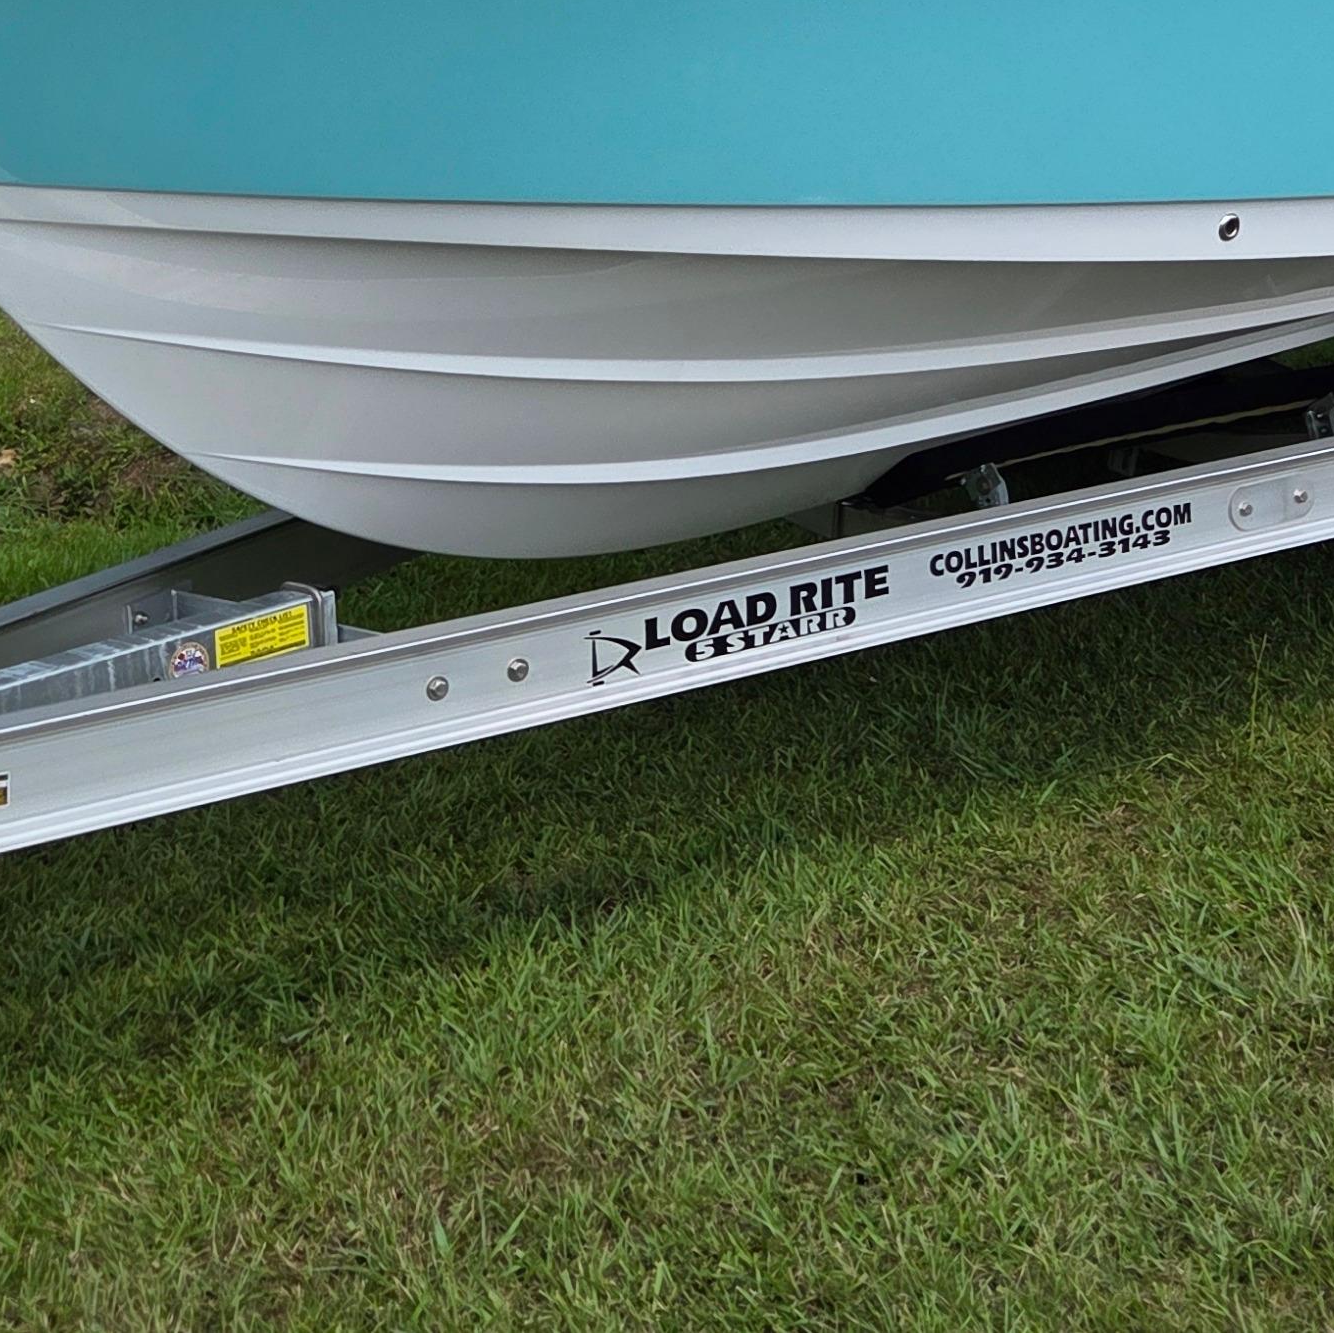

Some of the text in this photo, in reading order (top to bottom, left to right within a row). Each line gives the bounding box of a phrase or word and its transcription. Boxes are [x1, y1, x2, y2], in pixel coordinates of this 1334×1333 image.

[929, 502, 1192, 576] COLLINSBOATING.COM
[956, 529, 1171, 589] 919-934-3143
[644, 564, 890, 651] LOAD RITE
[694, 608, 848, 661] 5 STARR
